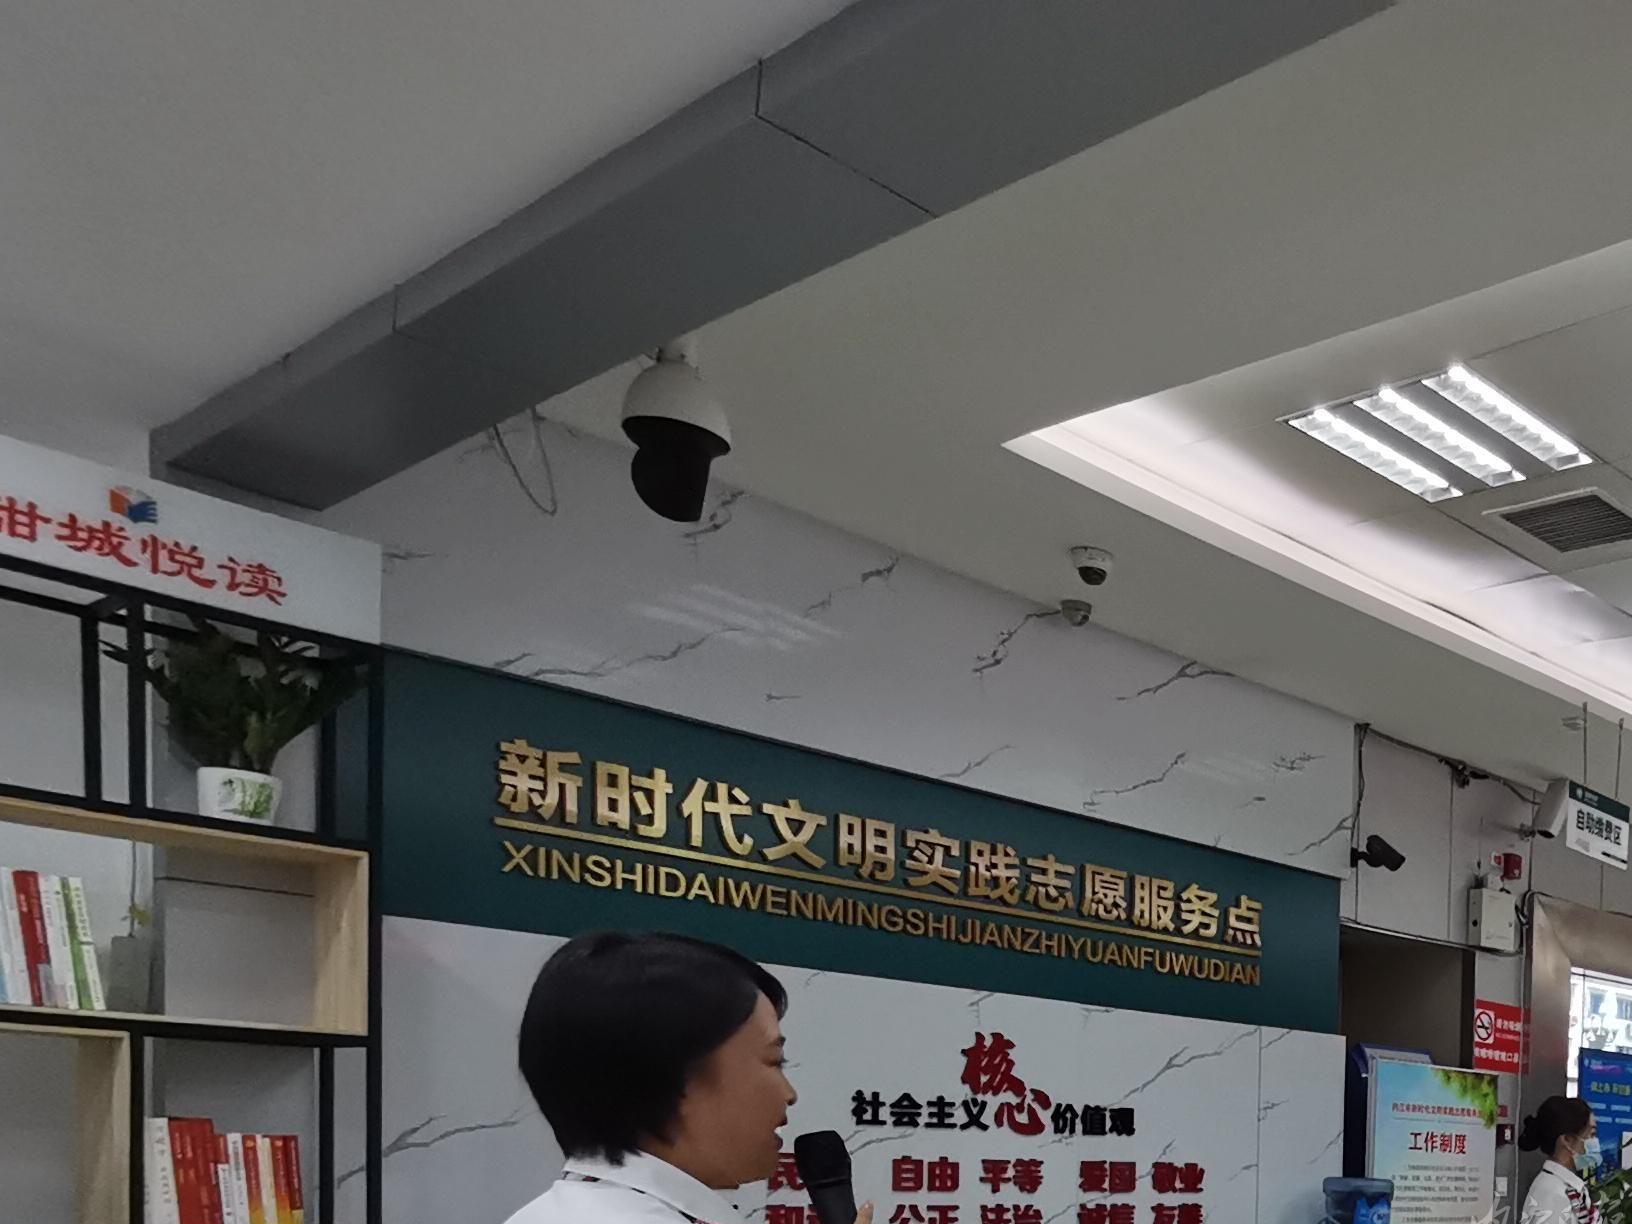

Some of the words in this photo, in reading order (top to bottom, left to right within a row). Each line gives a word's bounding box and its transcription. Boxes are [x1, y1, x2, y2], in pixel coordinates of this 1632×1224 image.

[496, 738, 1262, 948] 新时代文明实践志愿服务点
[502, 840, 1262, 987] XINSHIDAIWENMINGSHIJIANZHIYUANFUWUDIAN
[850, 1089, 991, 1132] 社会主义
[960, 1030, 1053, 1136] 核心
[1051, 1102, 1136, 1137] 价值观
[891, 1156, 960, 1193] 自由
[980, 1158, 1044, 1194] 平等
[1079, 1160, 1136, 1193] 爱国
[1151, 1161, 1205, 1194] 敬业
[1408, 1131, 1467, 1154] 工作制度
